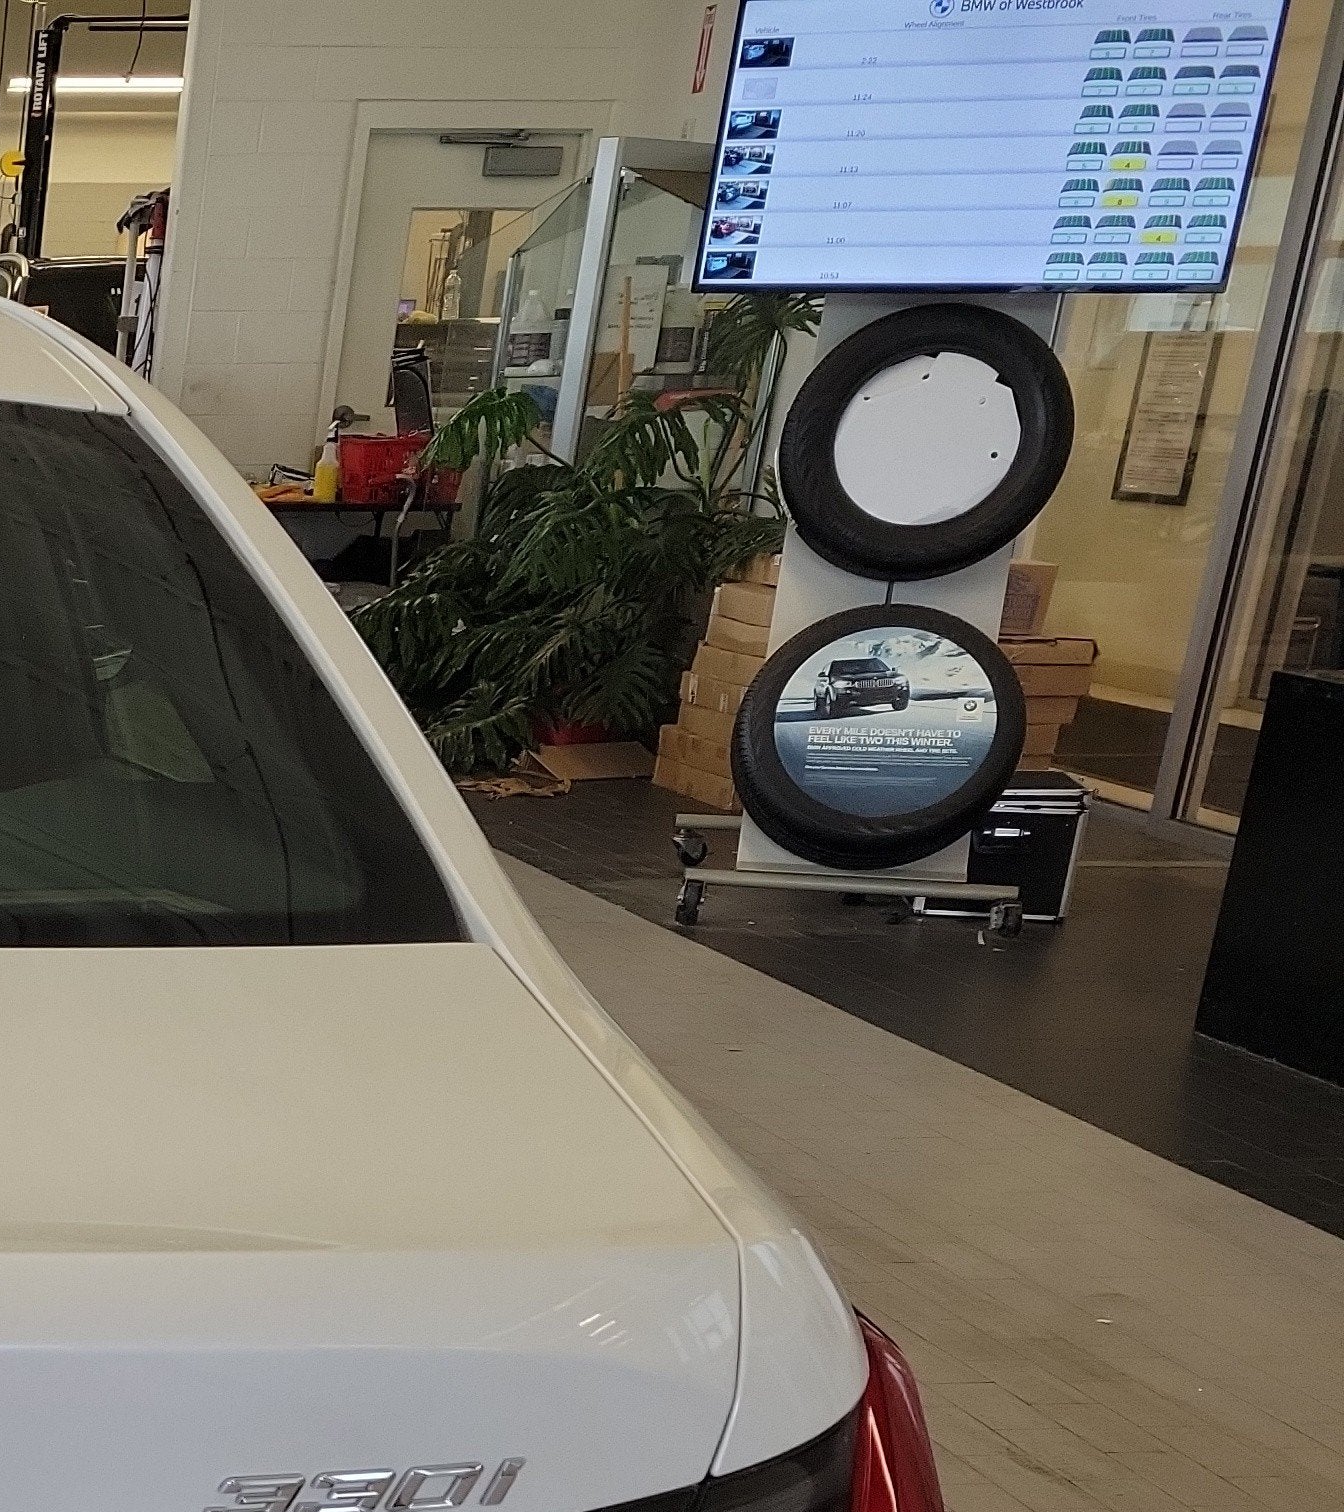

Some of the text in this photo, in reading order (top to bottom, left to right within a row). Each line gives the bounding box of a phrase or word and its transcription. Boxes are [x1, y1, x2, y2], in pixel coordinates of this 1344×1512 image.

[961, 0, 994, 12] BMW
[1016, 0, 1084, 10] Westbrook
[38, 32, 49, 58] LIFT
[809, 727, 961, 738] EVERY MILE DOESN'T HAVE TO
[808, 735, 953, 747] FEEL LIKE TWO THIS WINTER.
